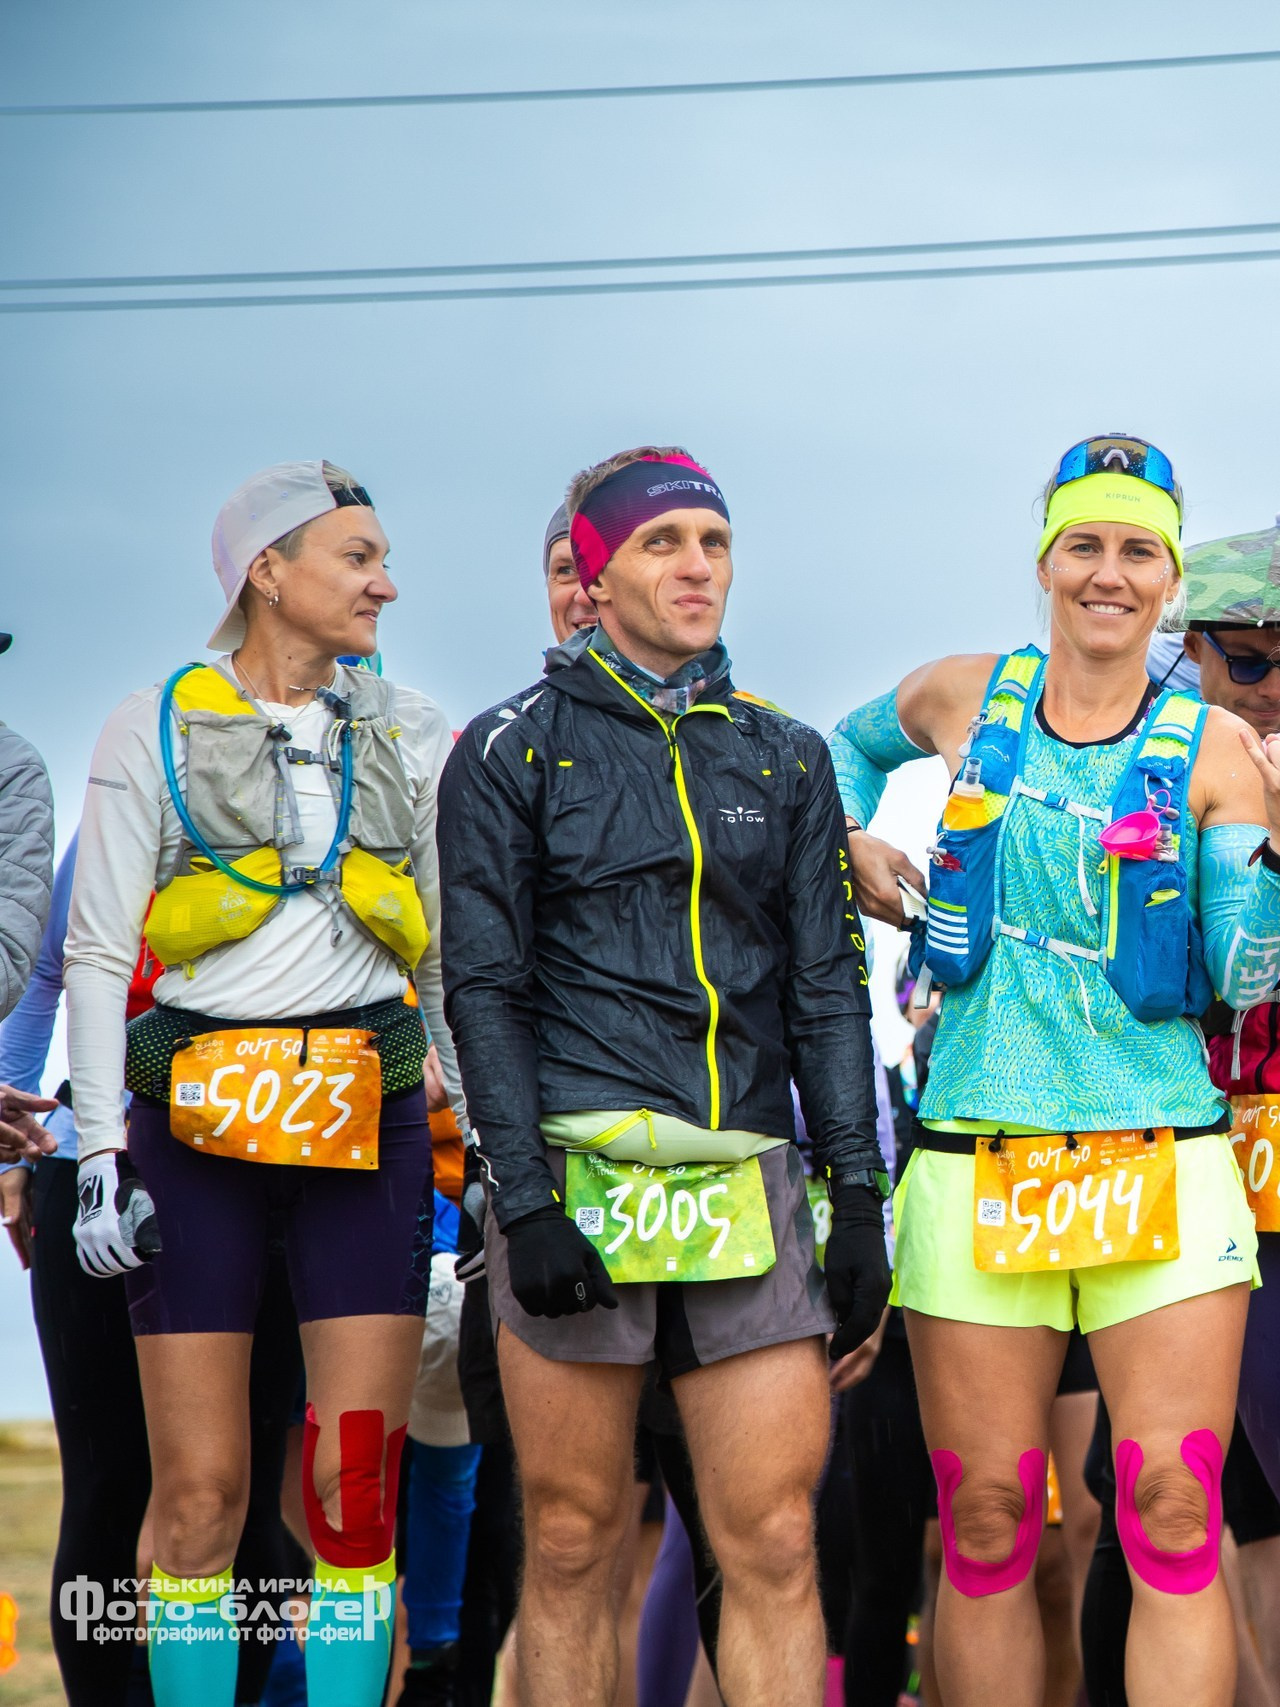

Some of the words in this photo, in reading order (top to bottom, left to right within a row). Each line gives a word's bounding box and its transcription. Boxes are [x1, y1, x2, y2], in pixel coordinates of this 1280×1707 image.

[1105, 492, 1141, 502] KIPRUN
[720, 814, 764, 824] glow
[236, 1038, 279, 1060] OUT
[281, 1039, 303, 1060] 50
[208, 1063, 356, 1140] 5023
[1027, 1146, 1064, 1172] OUT
[1070, 1145, 1091, 1169] 50
[604, 1182, 731, 1259] 3005
[1010, 1169, 1144, 1254] 5044
